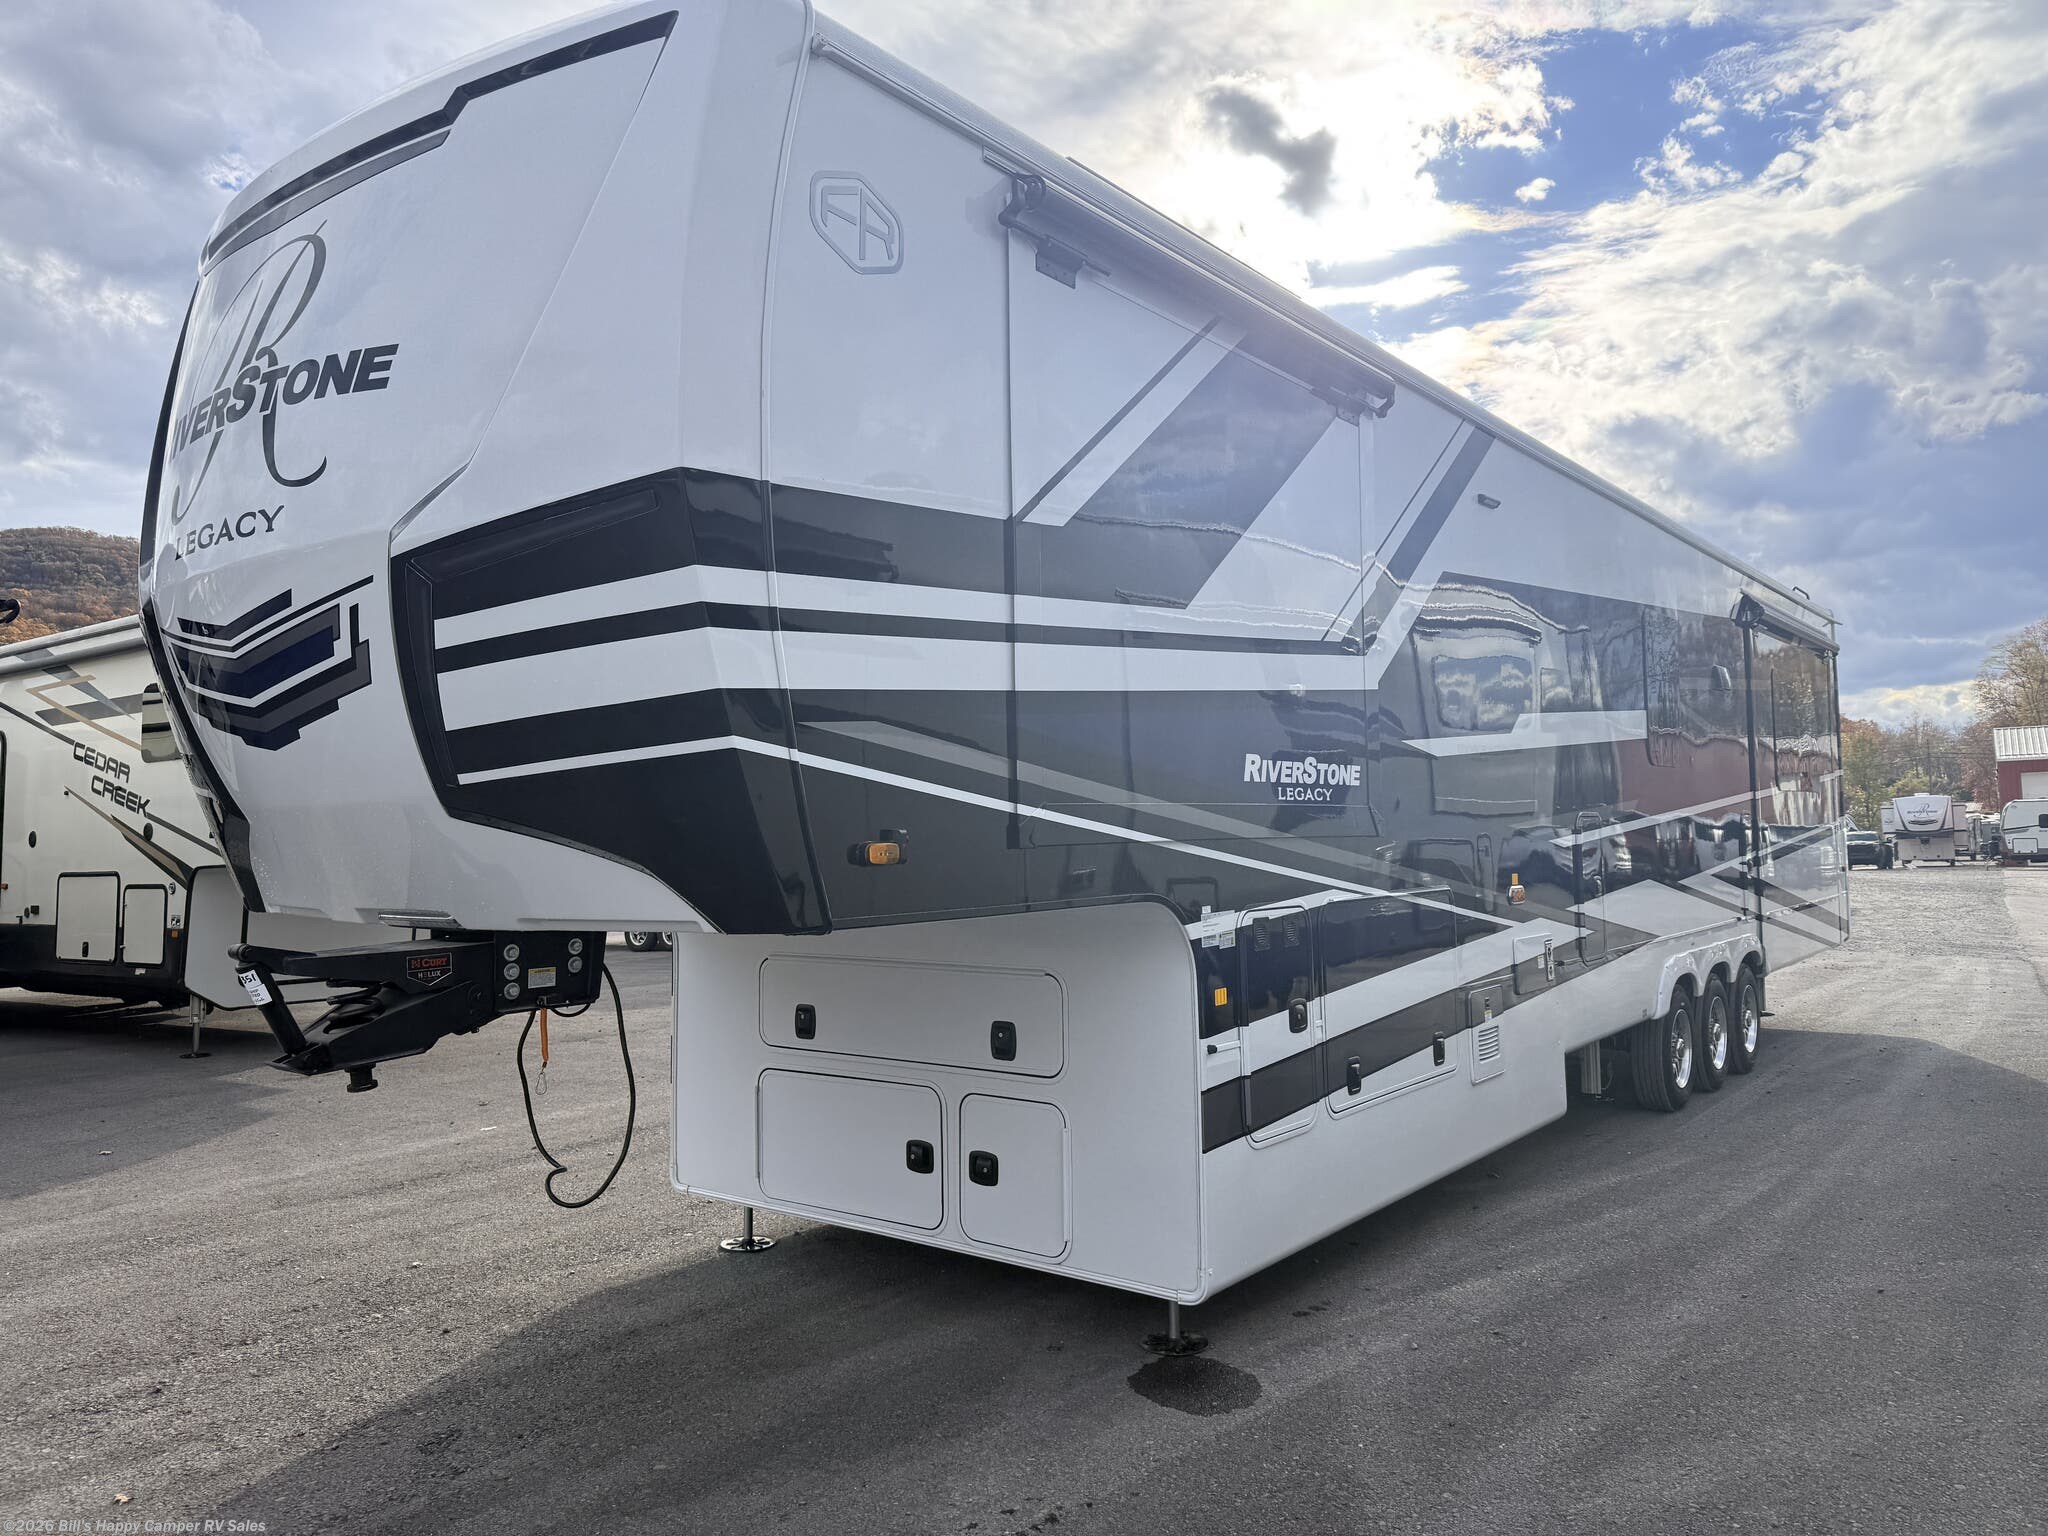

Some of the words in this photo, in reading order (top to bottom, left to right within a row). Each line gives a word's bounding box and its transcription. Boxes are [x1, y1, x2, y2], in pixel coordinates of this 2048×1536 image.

[169, 343, 399, 463] IVERSTONE
[174, 505, 285, 561] LEGACY
[73, 741, 131, 783] CEDAR
[91, 774, 150, 818] CREEK
[1277, 787, 1333, 801] LEGACY
